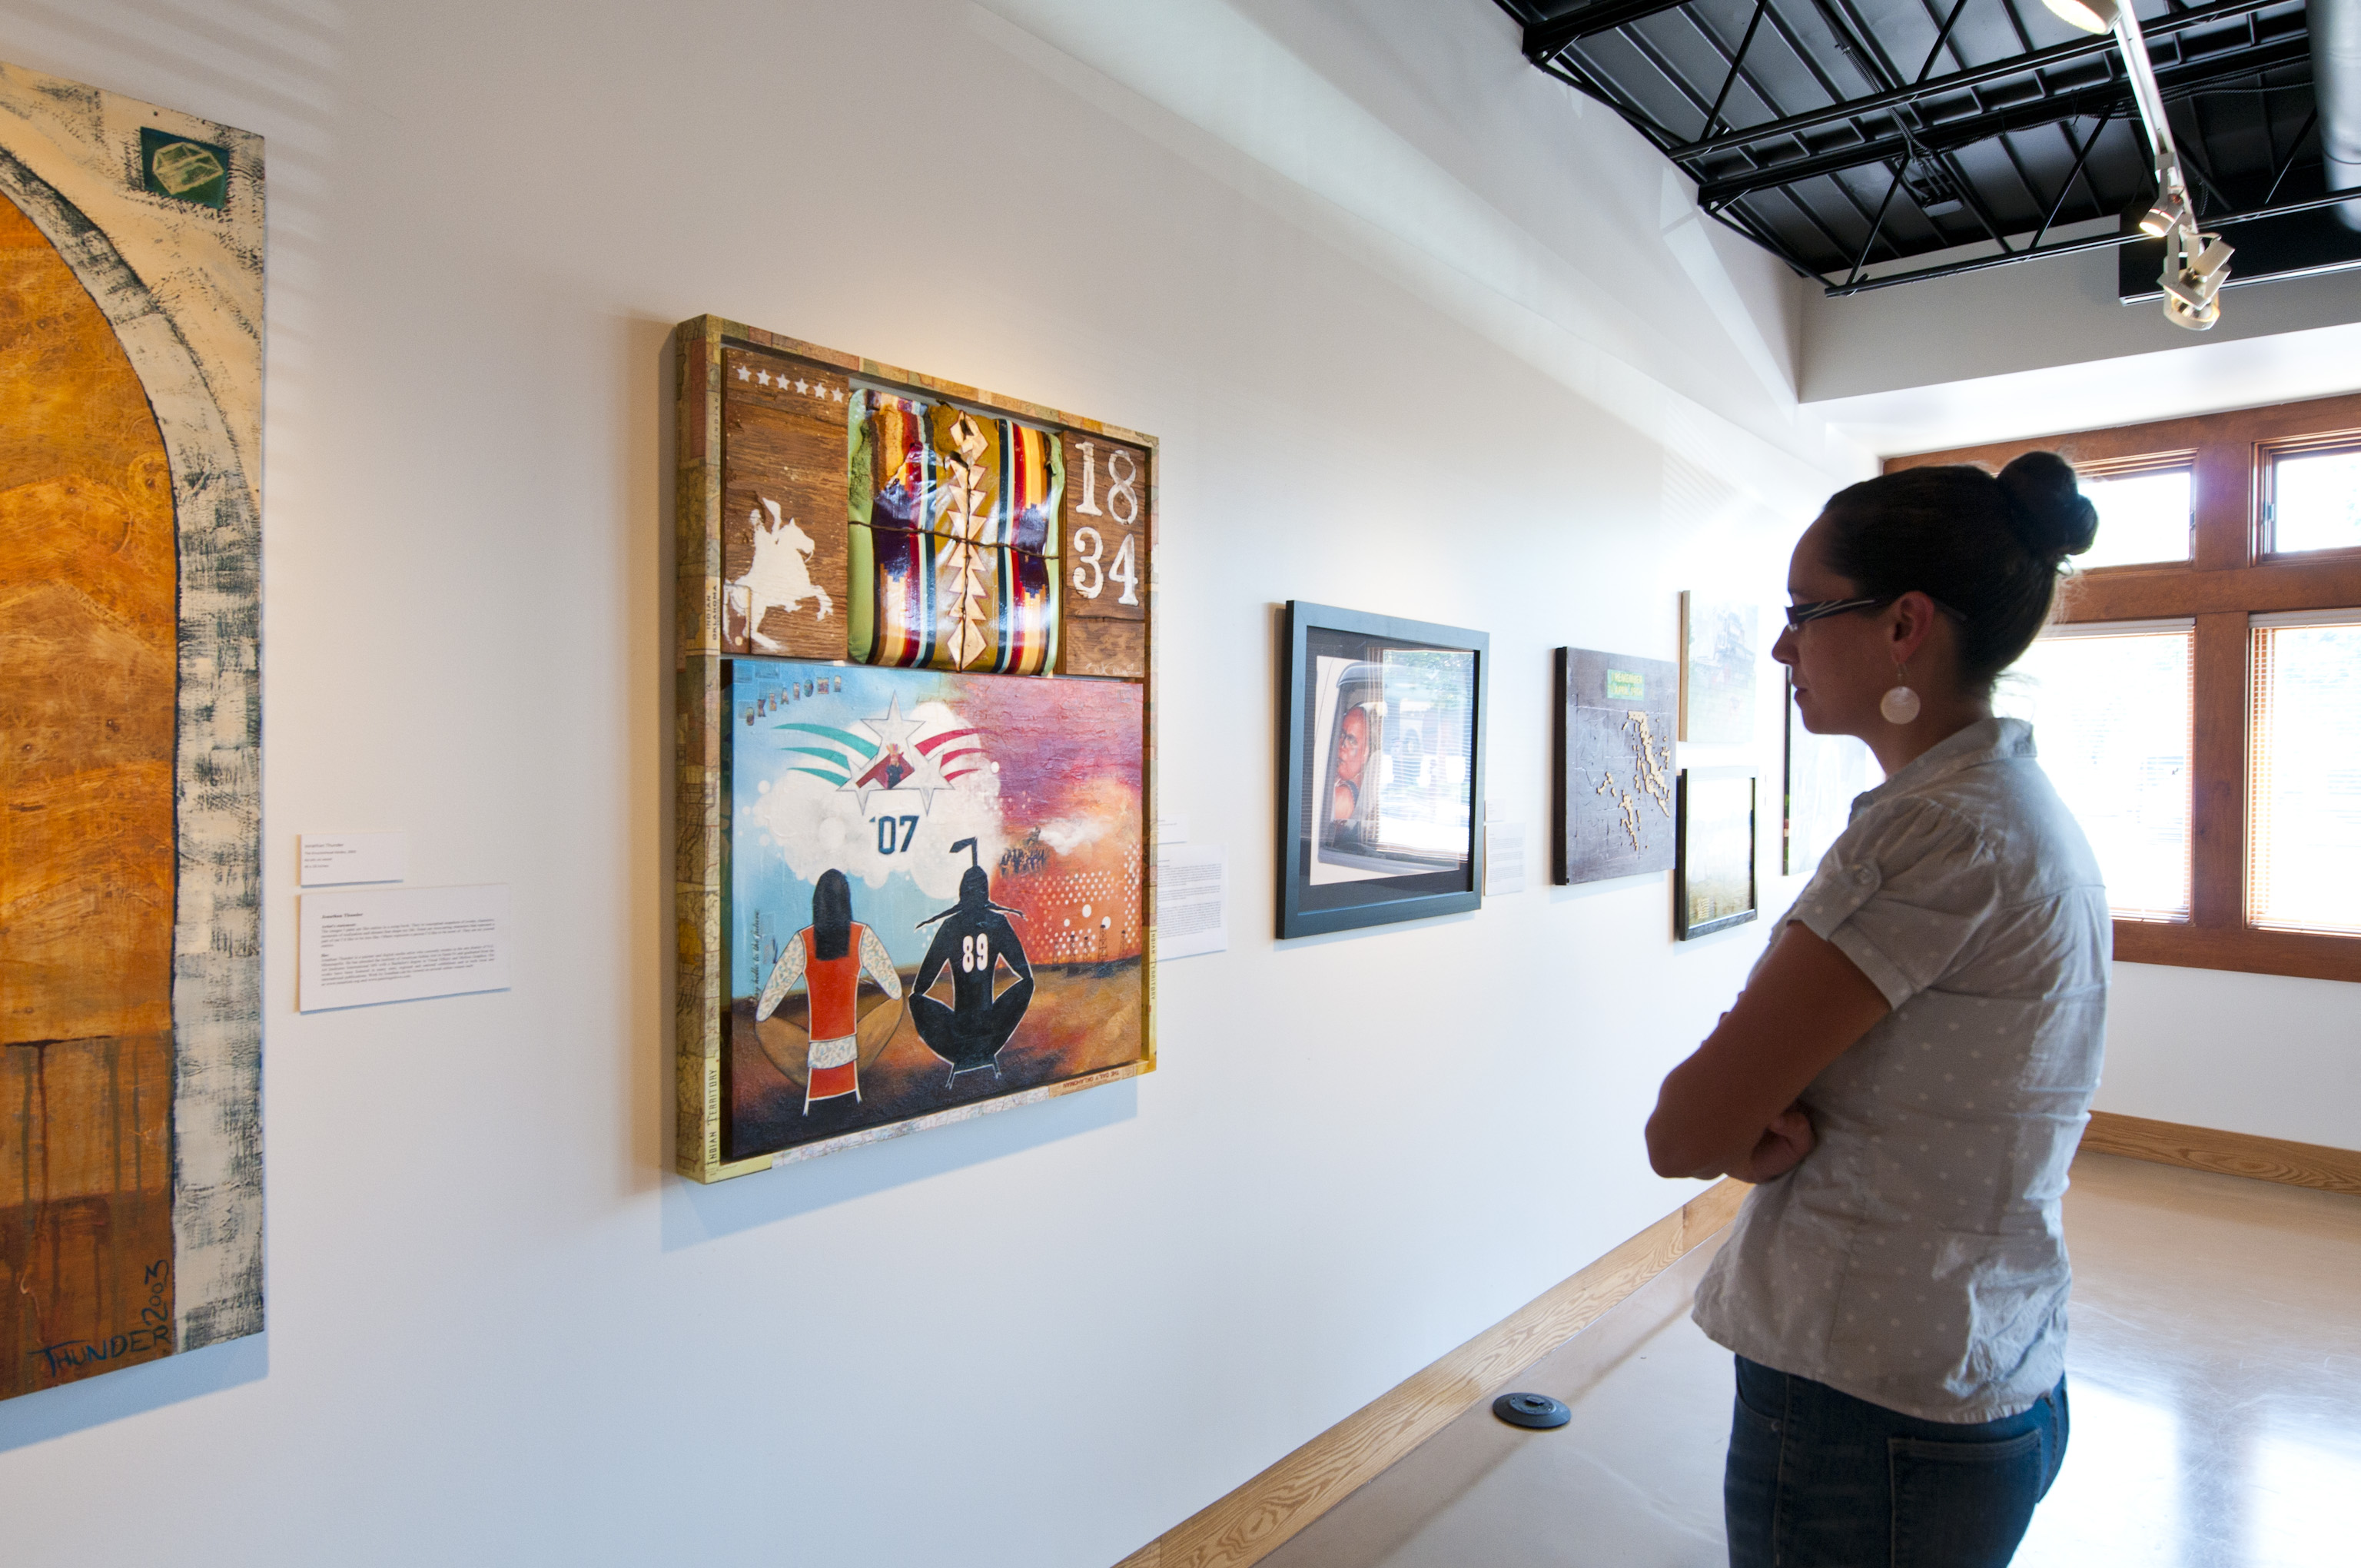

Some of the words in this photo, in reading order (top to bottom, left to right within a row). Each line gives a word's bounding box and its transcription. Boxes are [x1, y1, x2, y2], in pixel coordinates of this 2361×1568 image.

[1074, 440, 1139, 527] 18
[1072, 527, 1141, 608] 34
[961, 932, 990, 974] 89
[706, 1069, 719, 1126] TERRITORY
[706, 1131, 719, 1166] INDIAN
[141, 1259, 170, 1327] 2003
[25, 1324, 173, 1378] THUNDER
